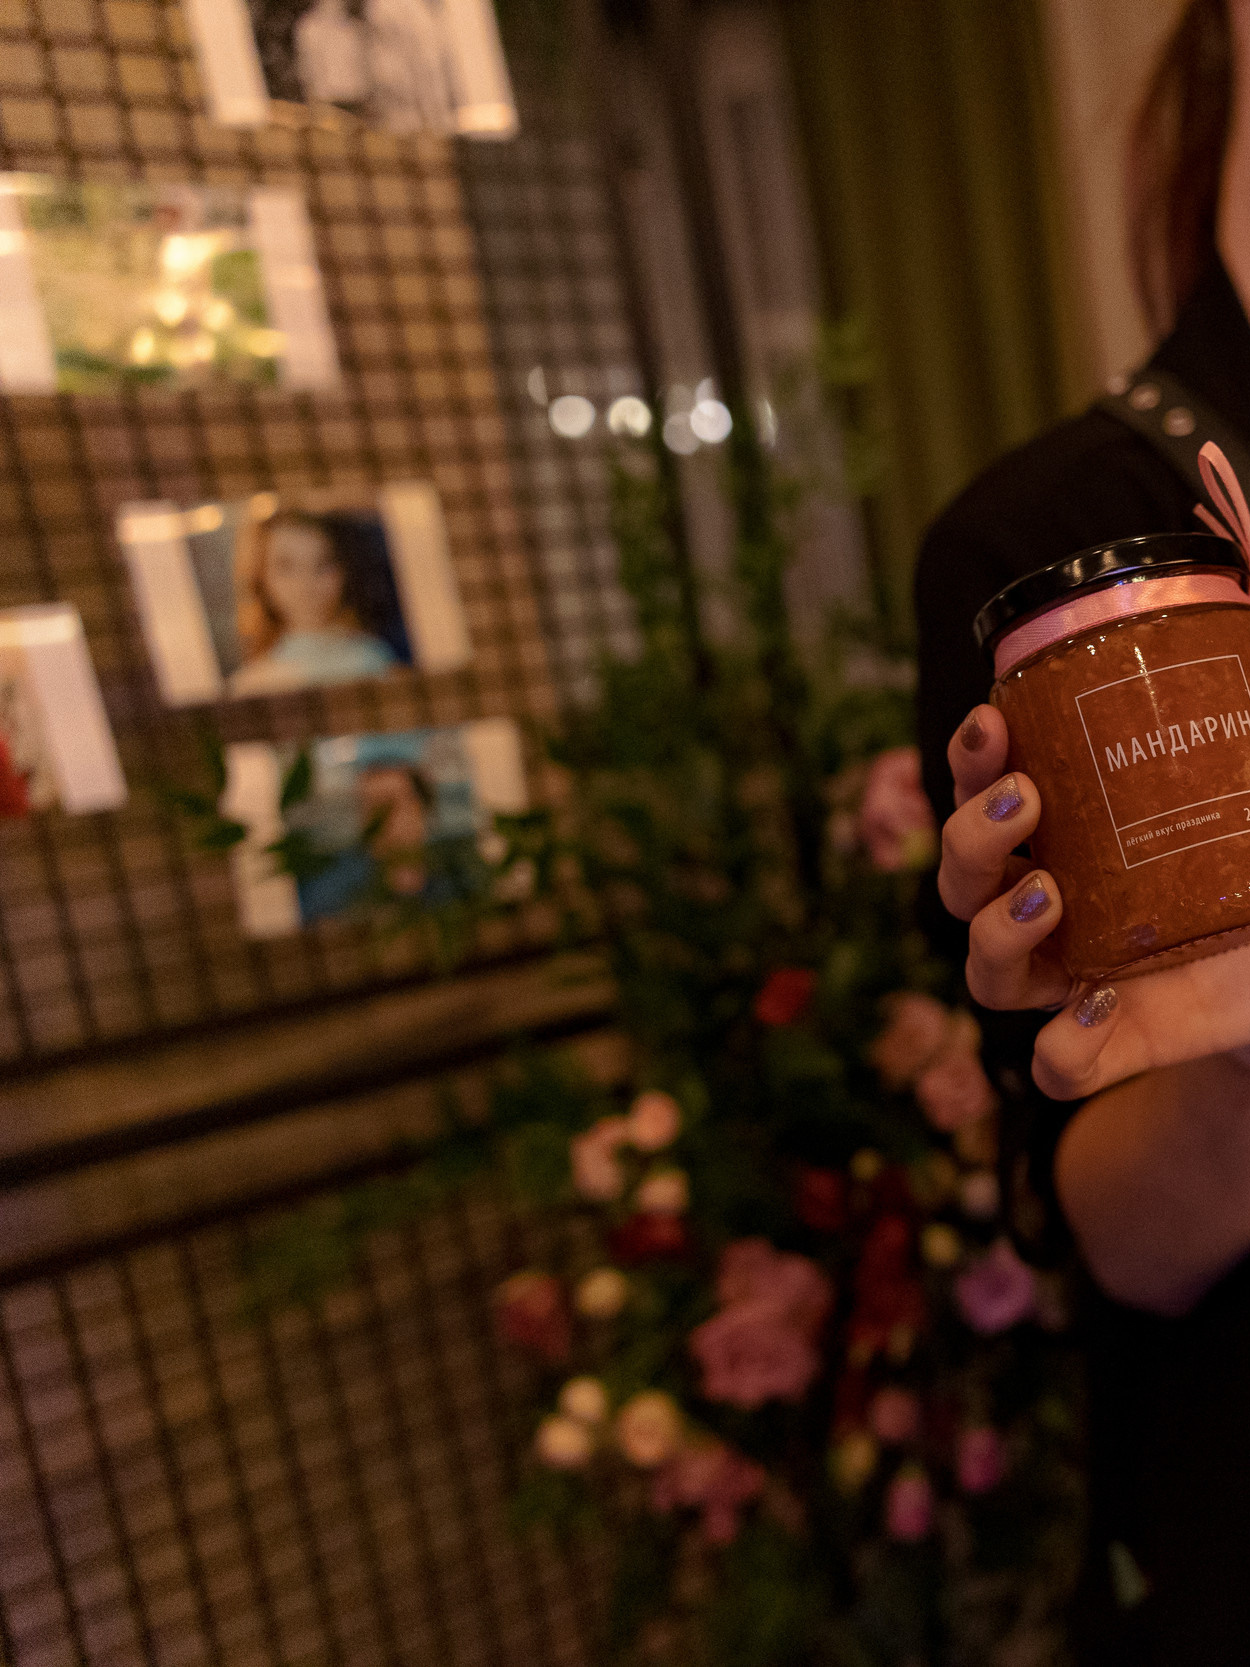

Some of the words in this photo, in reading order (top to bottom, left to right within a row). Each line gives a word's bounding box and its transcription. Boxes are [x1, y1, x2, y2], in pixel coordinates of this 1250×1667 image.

[1126, 831, 1154, 847] лёгкий
[1155, 824, 1175, 837] вкус
[1176, 812, 1221, 831] праздника
